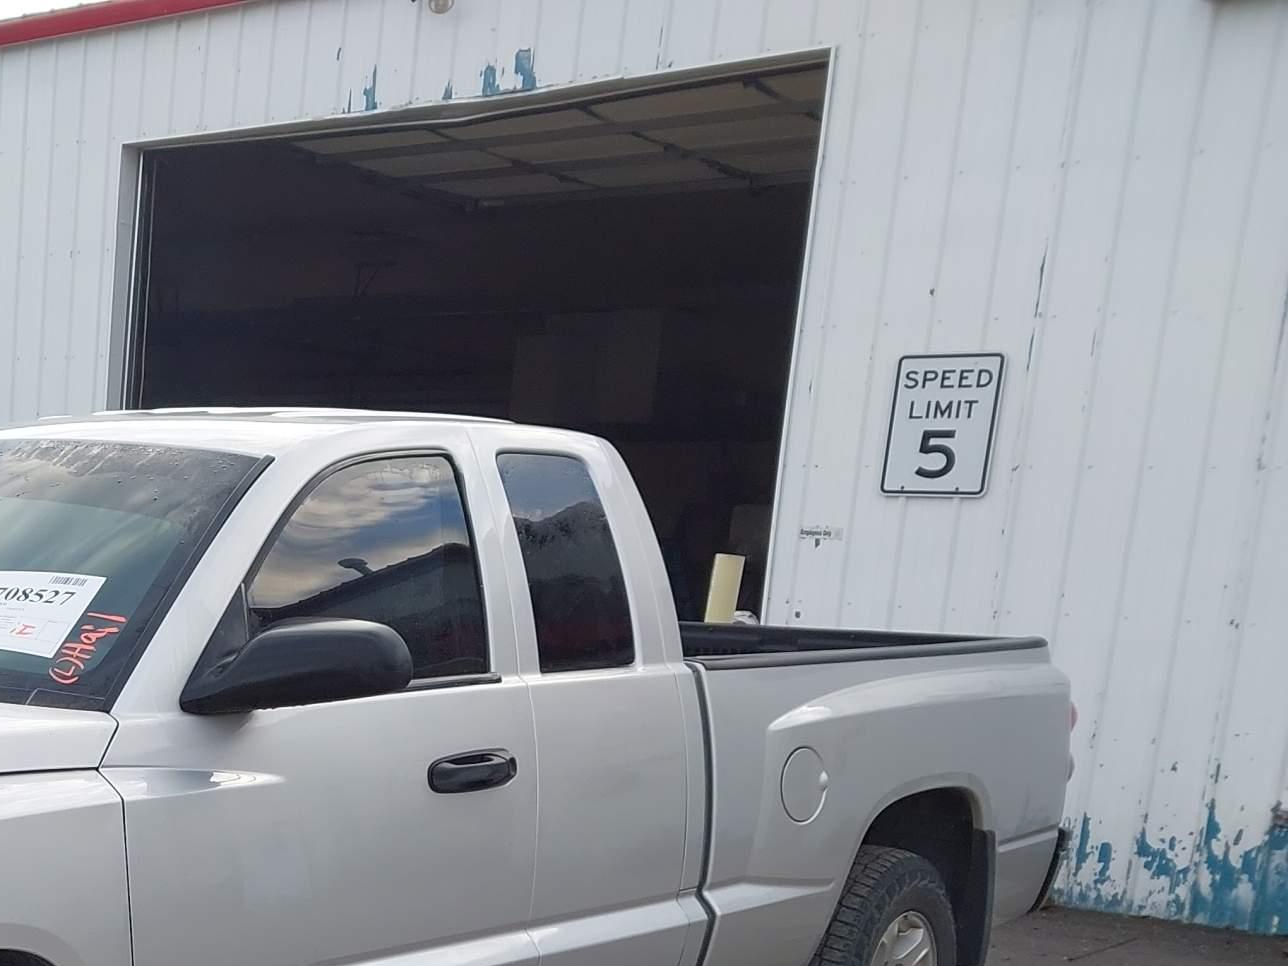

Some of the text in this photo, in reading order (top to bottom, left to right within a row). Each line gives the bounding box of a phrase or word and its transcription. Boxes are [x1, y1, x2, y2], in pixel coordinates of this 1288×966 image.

[903, 369, 993, 390] SPEED
[908, 400, 979, 419] LIMIT
[914, 429, 957, 479] 5
